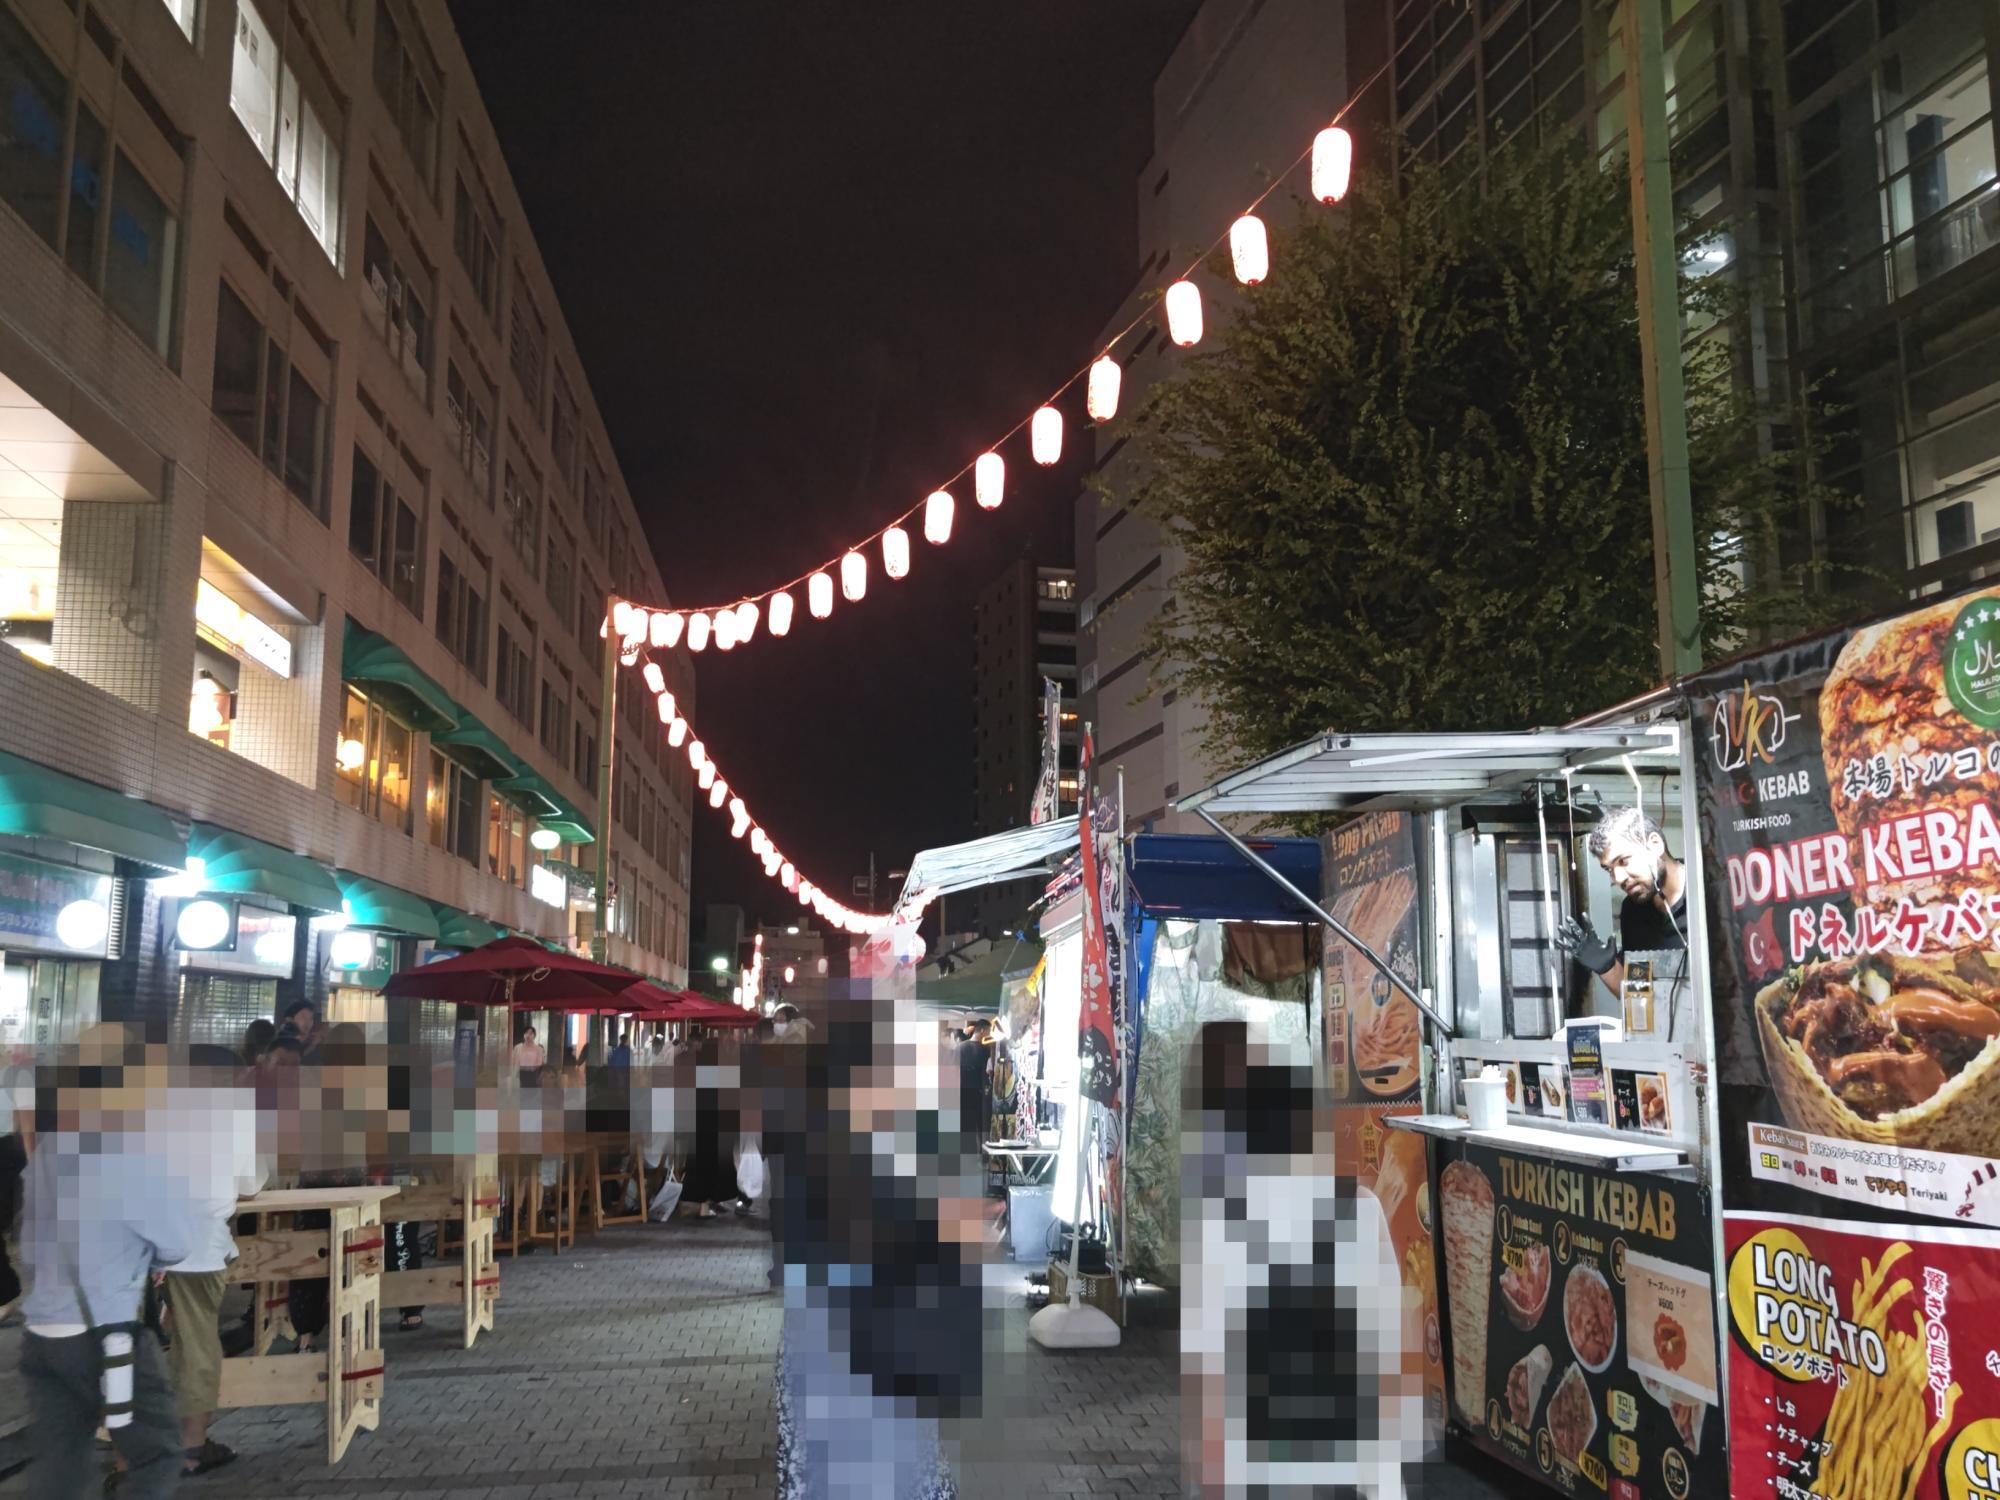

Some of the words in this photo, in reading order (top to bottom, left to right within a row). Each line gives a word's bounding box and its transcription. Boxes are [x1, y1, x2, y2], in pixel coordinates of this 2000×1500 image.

[1758, 770, 1811, 803] KEBAB
[1732, 816, 1767, 832] TURKISH
[1768, 813, 1792, 830] FOOD
[1727, 833, 1856, 908] DONER
[1760, 1152, 1780, 1171] 甘口
[1845, 1176, 1859, 1187] Hot
[1865, 1175, 1908, 1198] てりやき
[1911, 1186, 1948, 1201] Teriyaki
[1593, 1175, 1677, 1242] KEBAB
[1558, 1224, 1568, 1261] 2
[1753, 1242, 1840, 1319] LONG
[1754, 1292, 1888, 1377] POTATO
[1760, 1342, 1849, 1389] ロングポテト
[1776, 1396, 1797, 1418] しお
[1776, 1423, 1834, 1456] ケチャップ
[1776, 1450, 1812, 1477] チーズ
